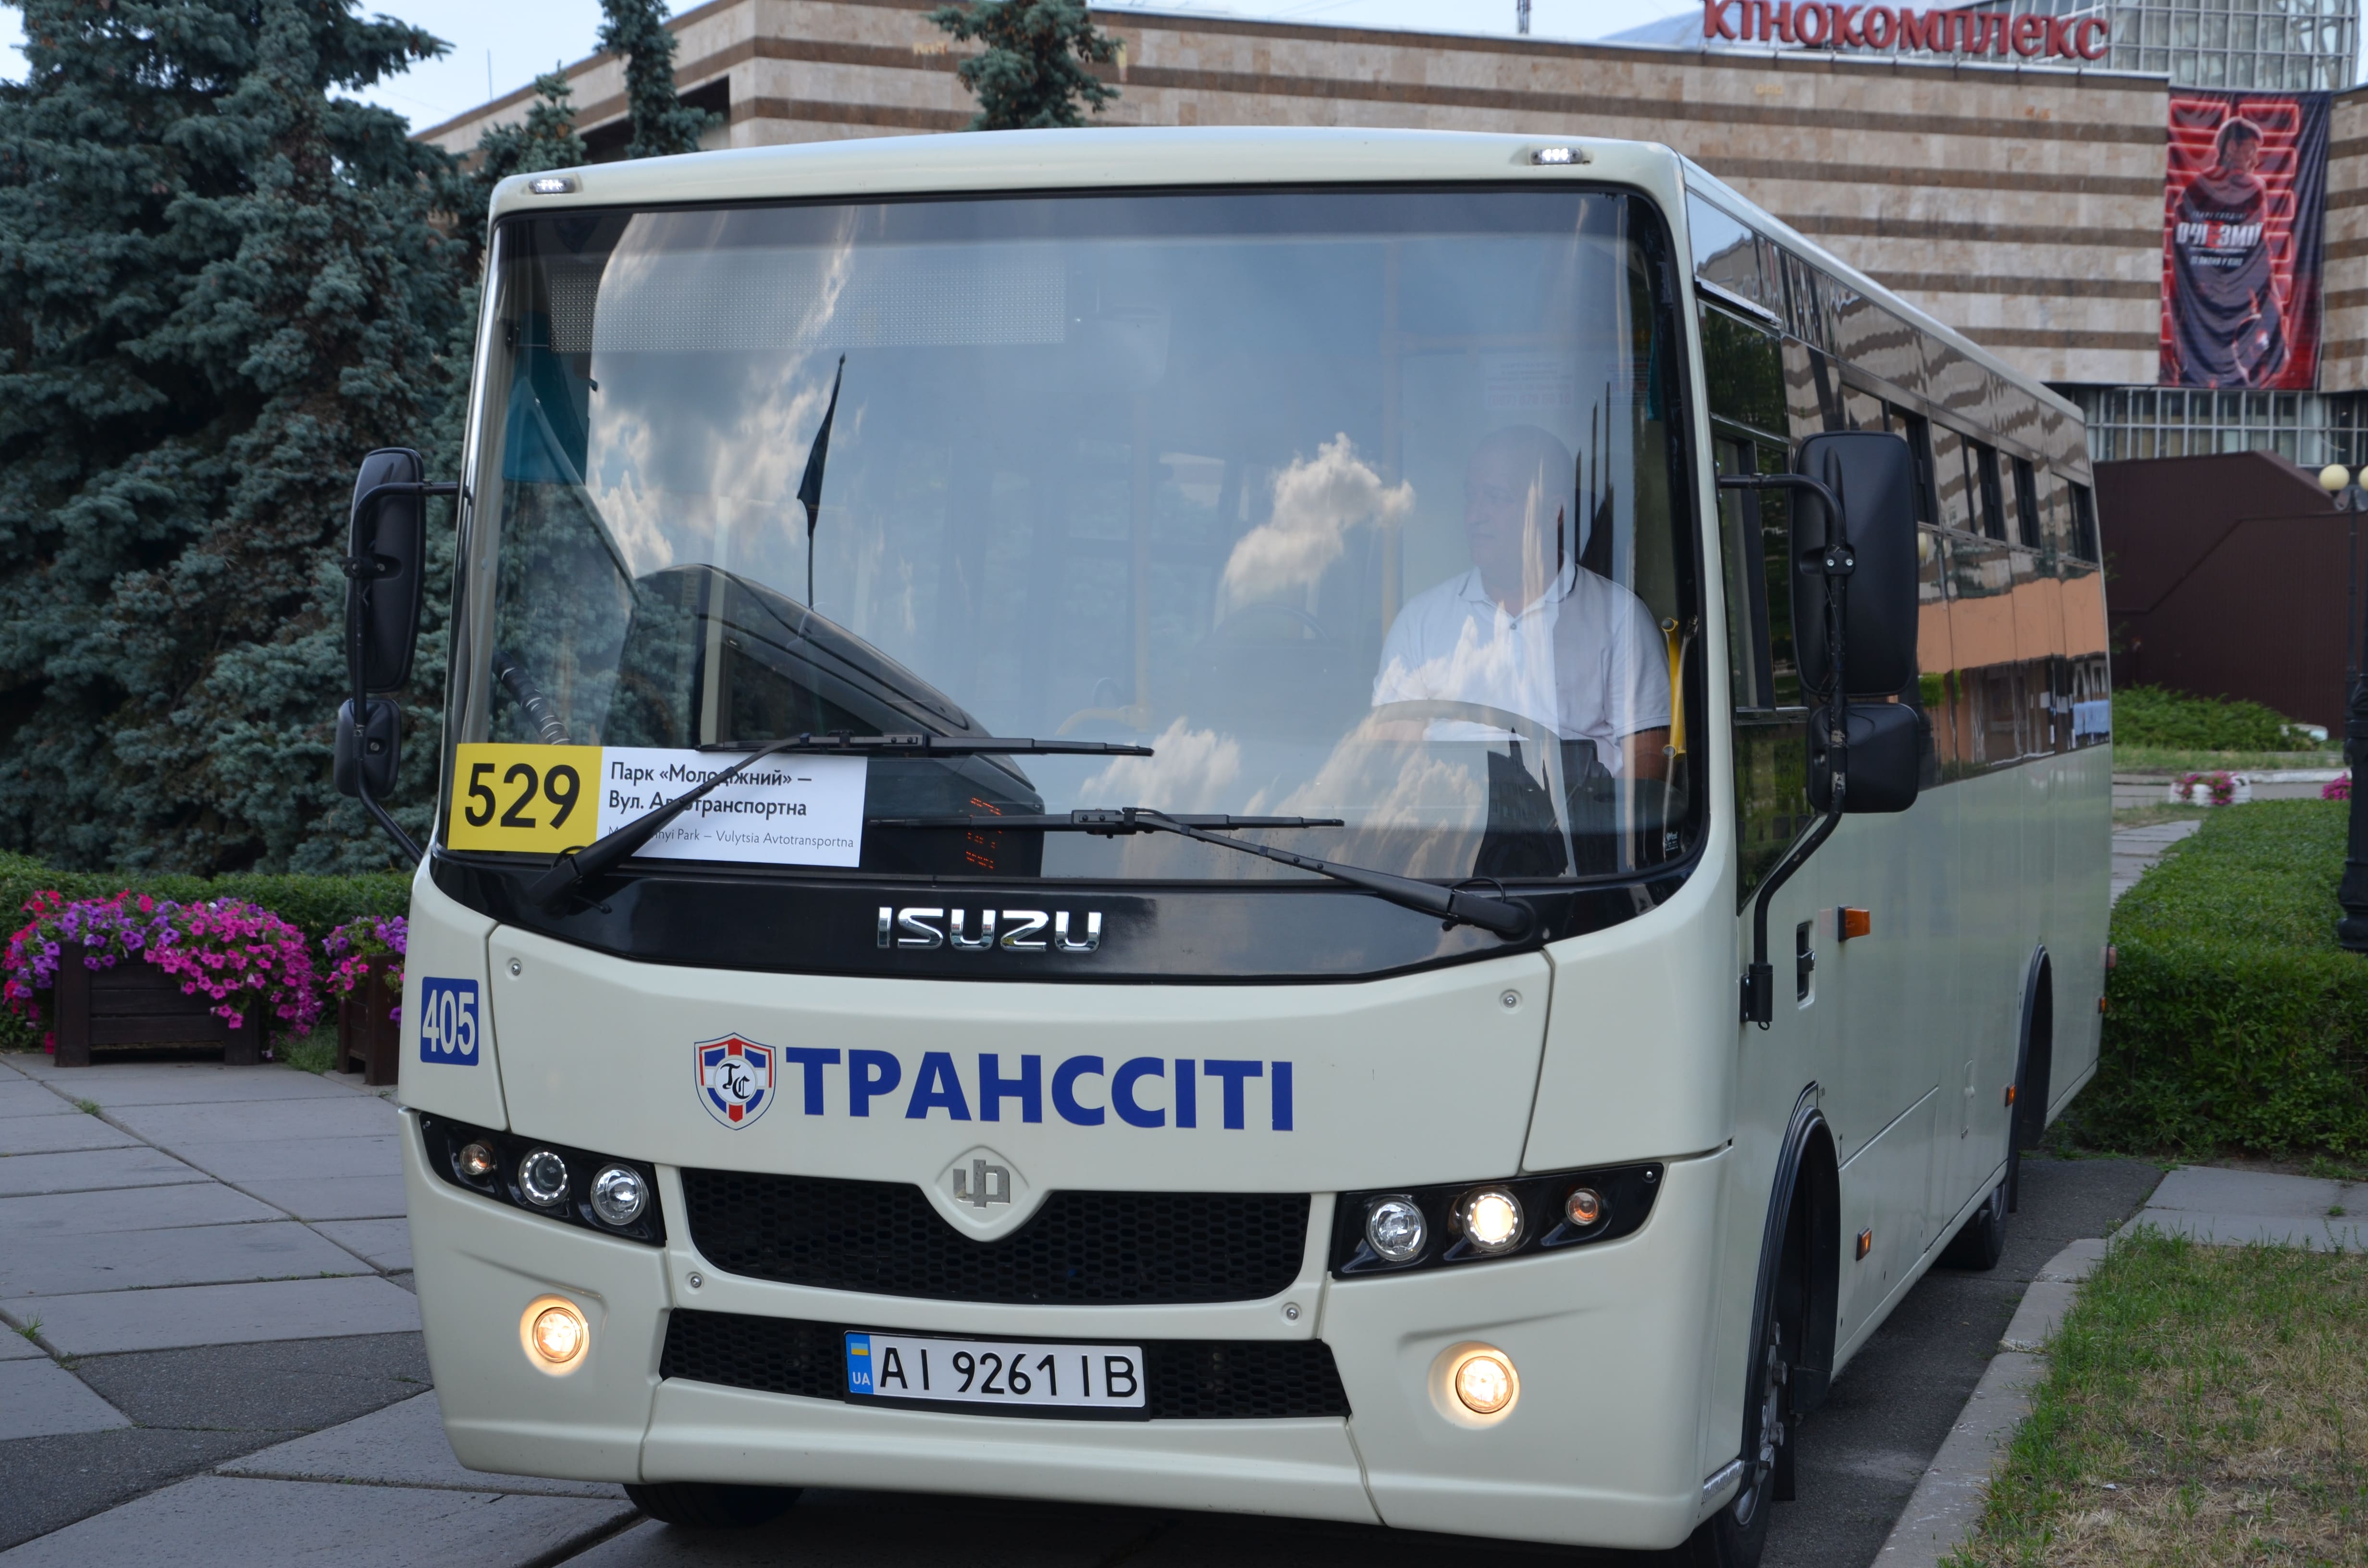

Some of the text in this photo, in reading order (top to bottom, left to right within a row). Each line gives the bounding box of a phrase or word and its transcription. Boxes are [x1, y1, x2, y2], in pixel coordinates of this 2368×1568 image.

[465, 763, 581, 830] 529
[611, 761, 654, 786] Парк
[609, 789, 644, 815] Вул.
[678, 829, 700, 841] Park
[716, 830, 760, 846] Vulytsia
[763, 833, 854, 850] Avtotransportna
[877, 906, 1102, 953] ISUZU
[422, 989, 476, 1055] 405
[786, 1046, 1294, 1131] ТРАНССІТІ
[852, 1372, 871, 1386] UA
[880, 1347, 1138, 1398] AI 9261 IB
